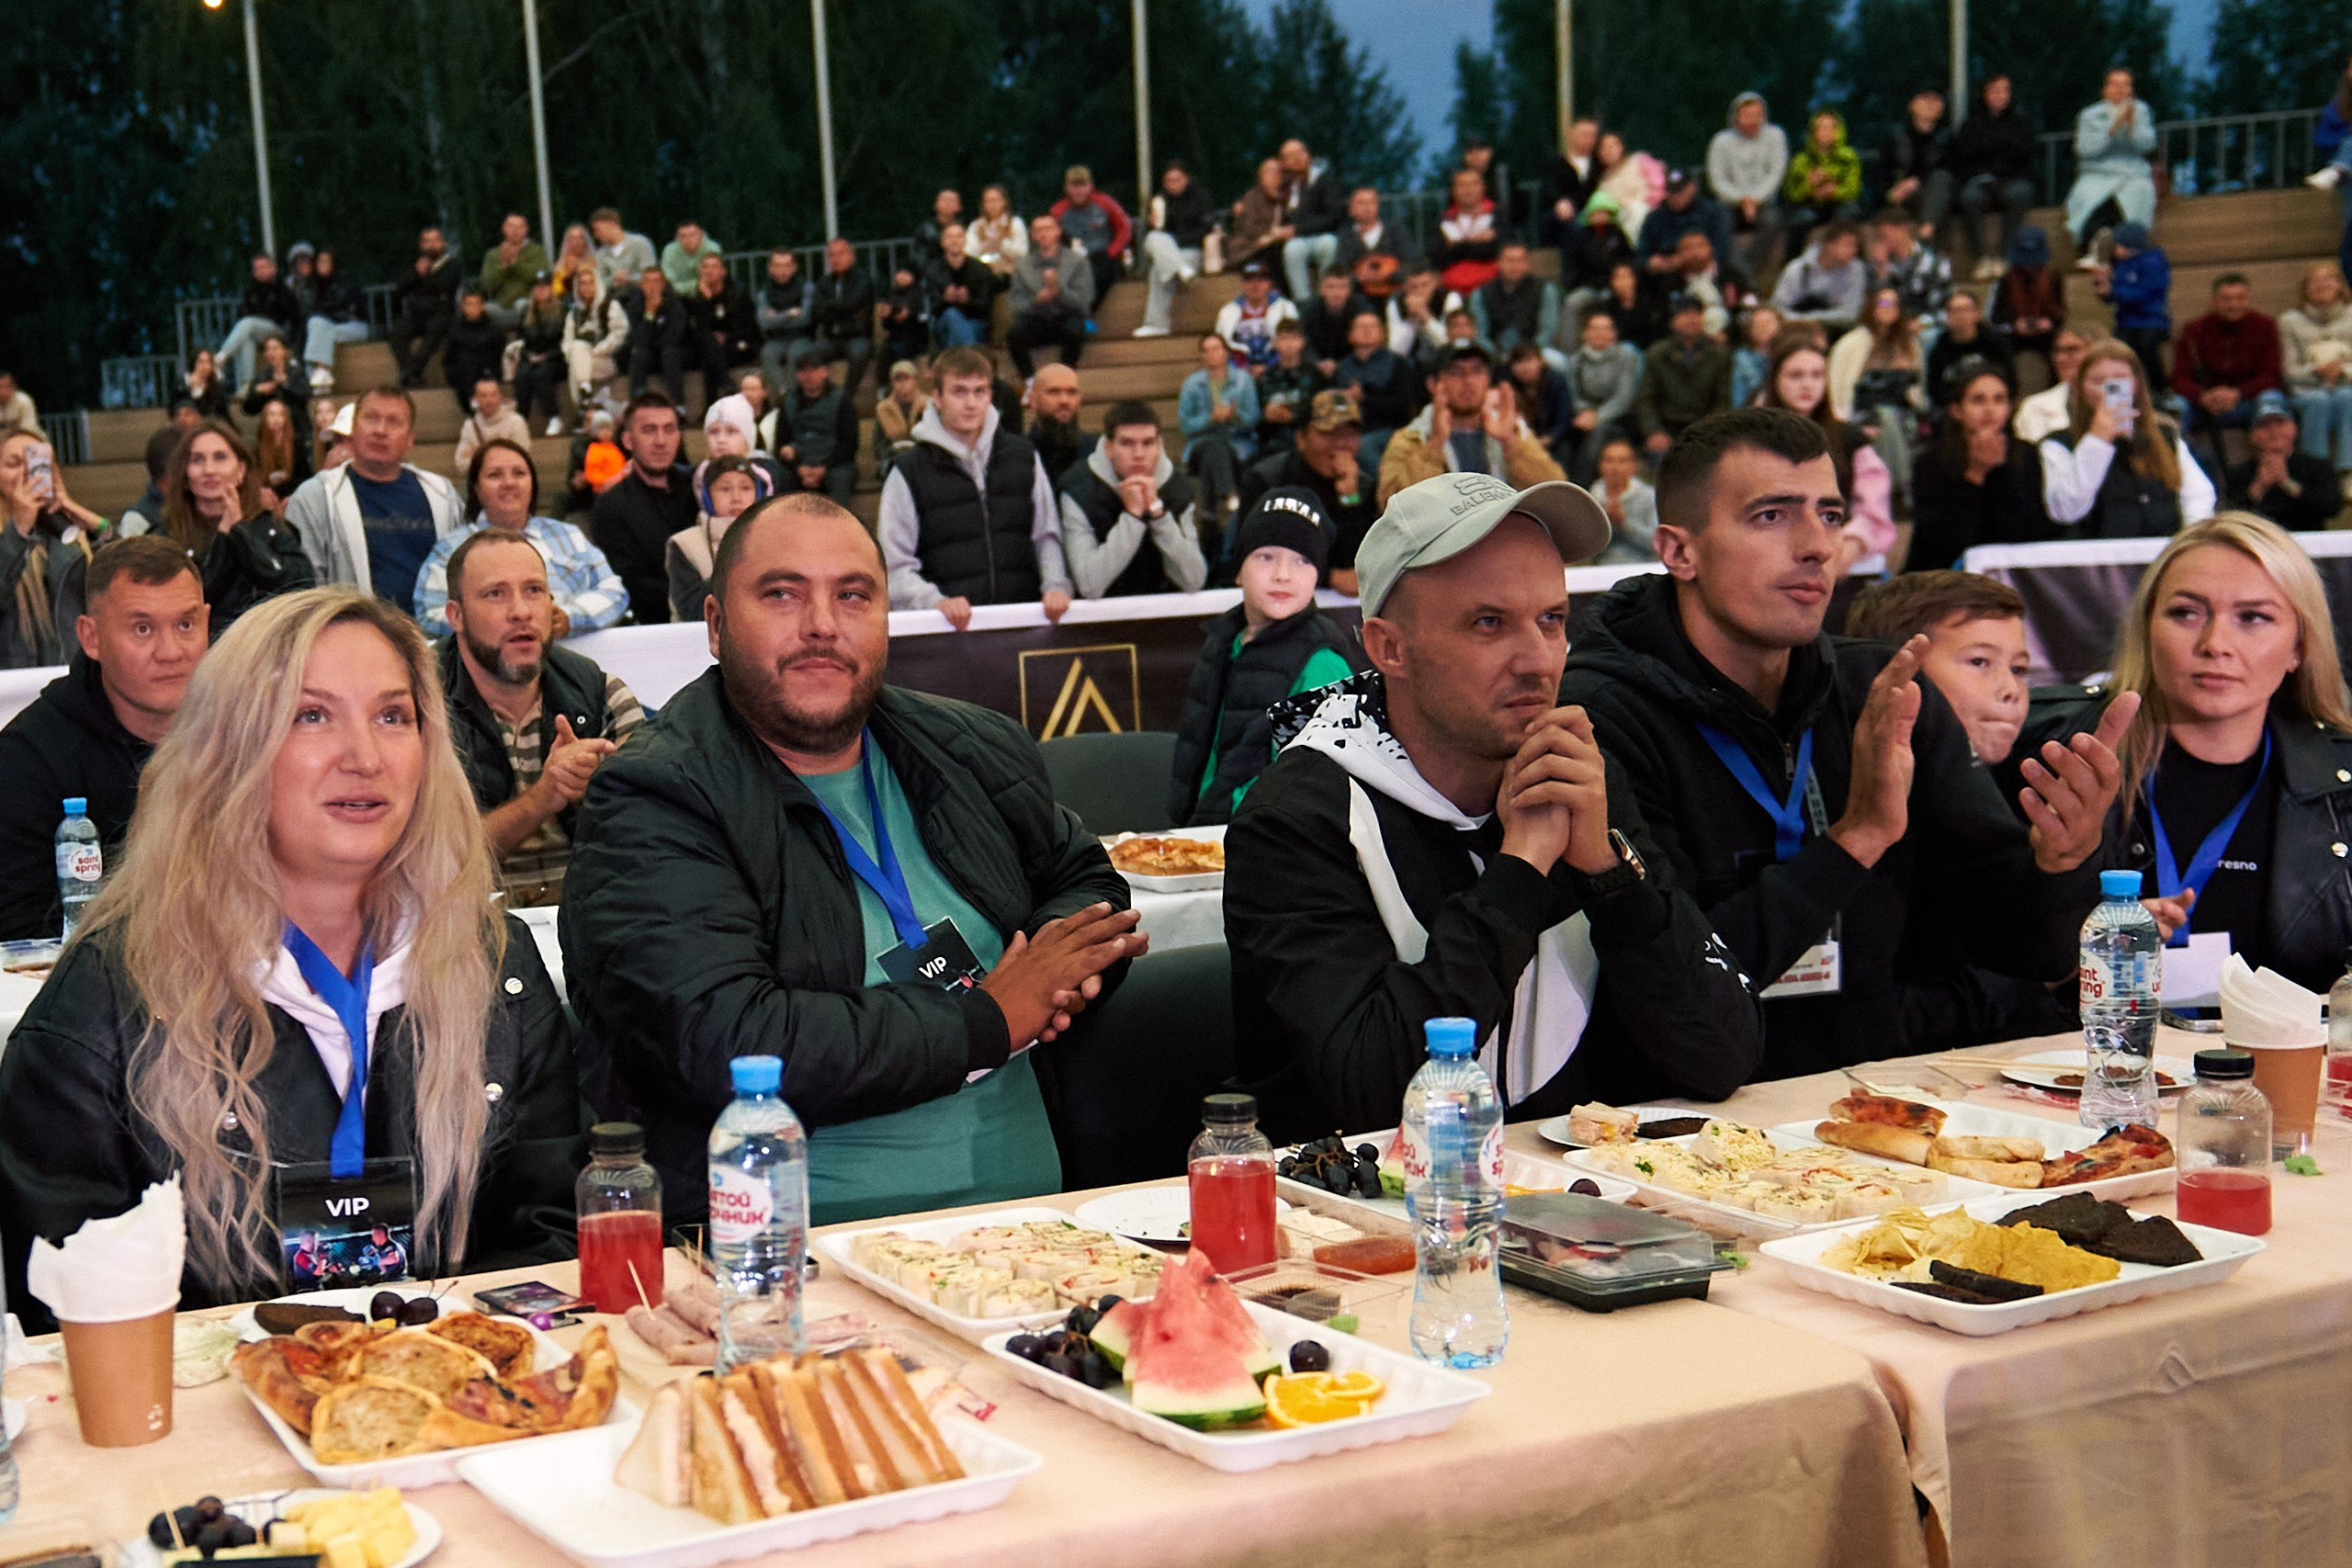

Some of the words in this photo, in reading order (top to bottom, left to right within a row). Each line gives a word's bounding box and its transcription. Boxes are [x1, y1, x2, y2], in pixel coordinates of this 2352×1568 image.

[2217, 860, 2257, 872] resno
[919, 956, 947, 979] VIP
[325, 1197, 369, 1217] VIP
